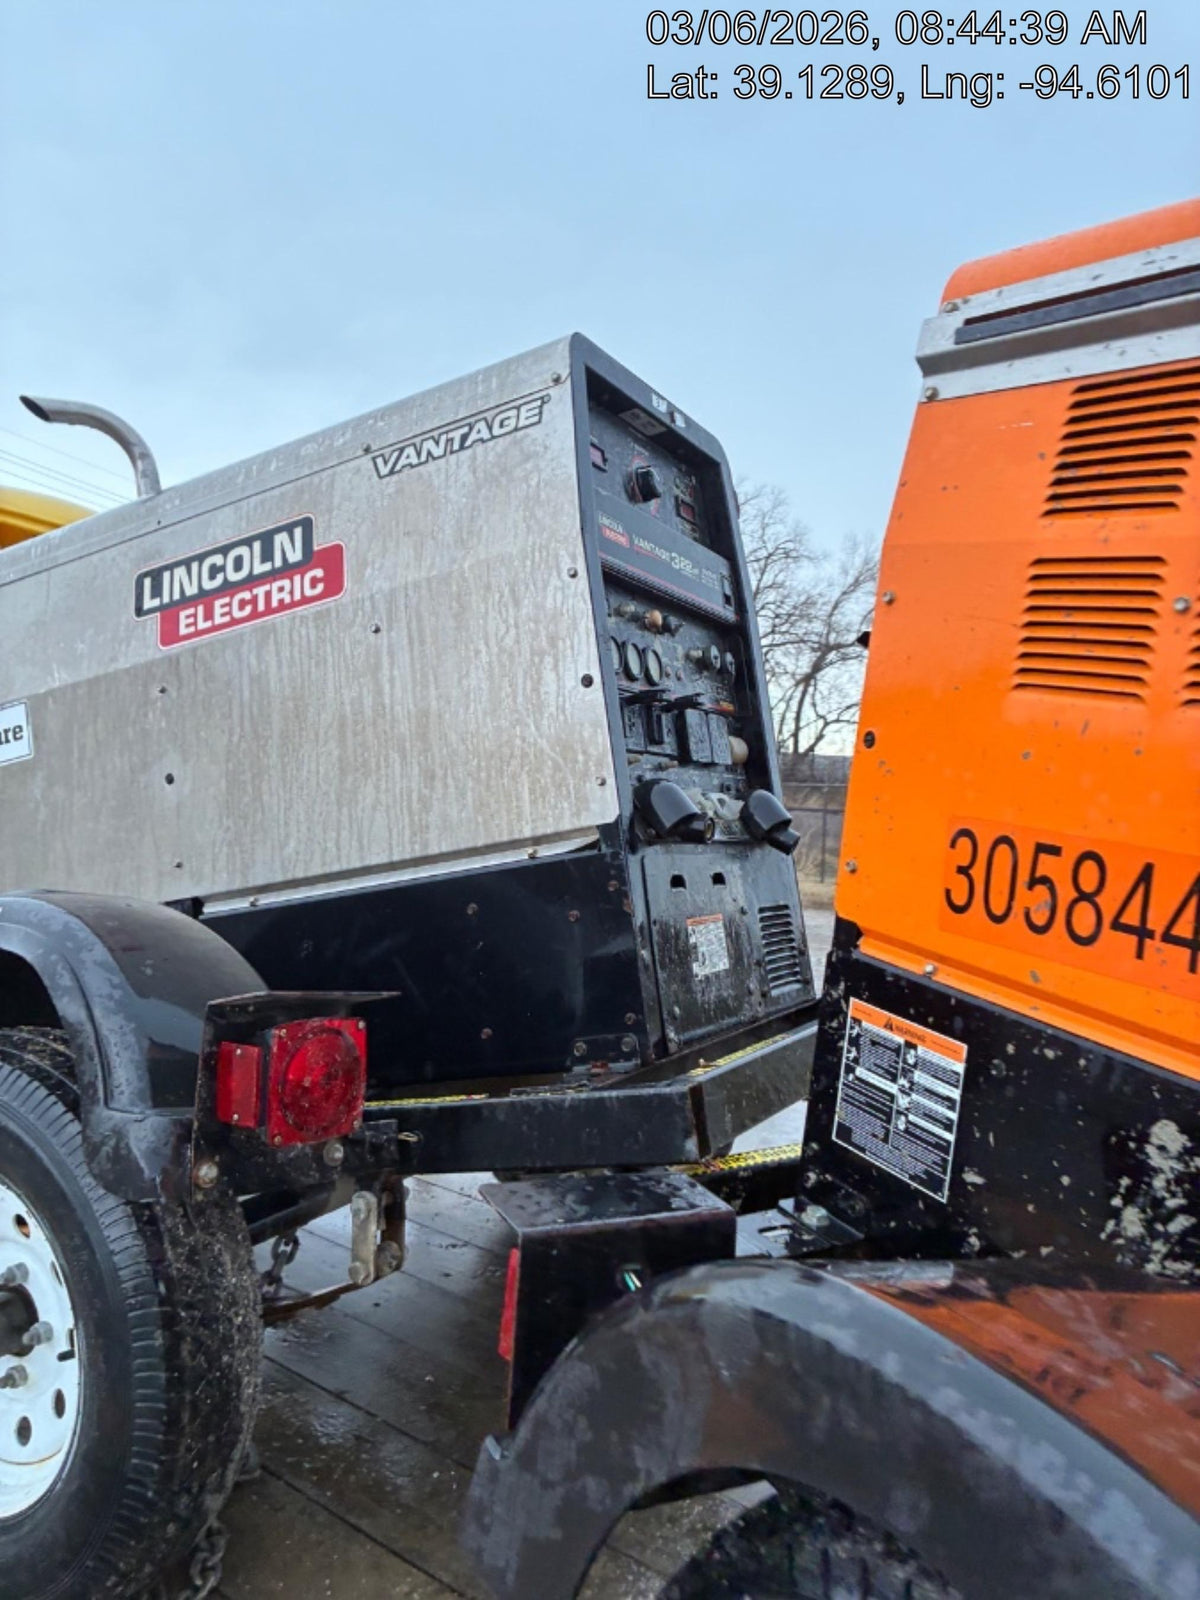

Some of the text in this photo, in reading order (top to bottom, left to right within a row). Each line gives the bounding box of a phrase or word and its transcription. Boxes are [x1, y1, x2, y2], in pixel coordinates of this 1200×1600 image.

[372, 396, 543, 480] VANTAGE
[142, 525, 304, 612] LINCOLN
[178, 567, 325, 637] ELECTRIC
[0, 724, 24, 746] re
[944, 827, 1200, 975] 305844
